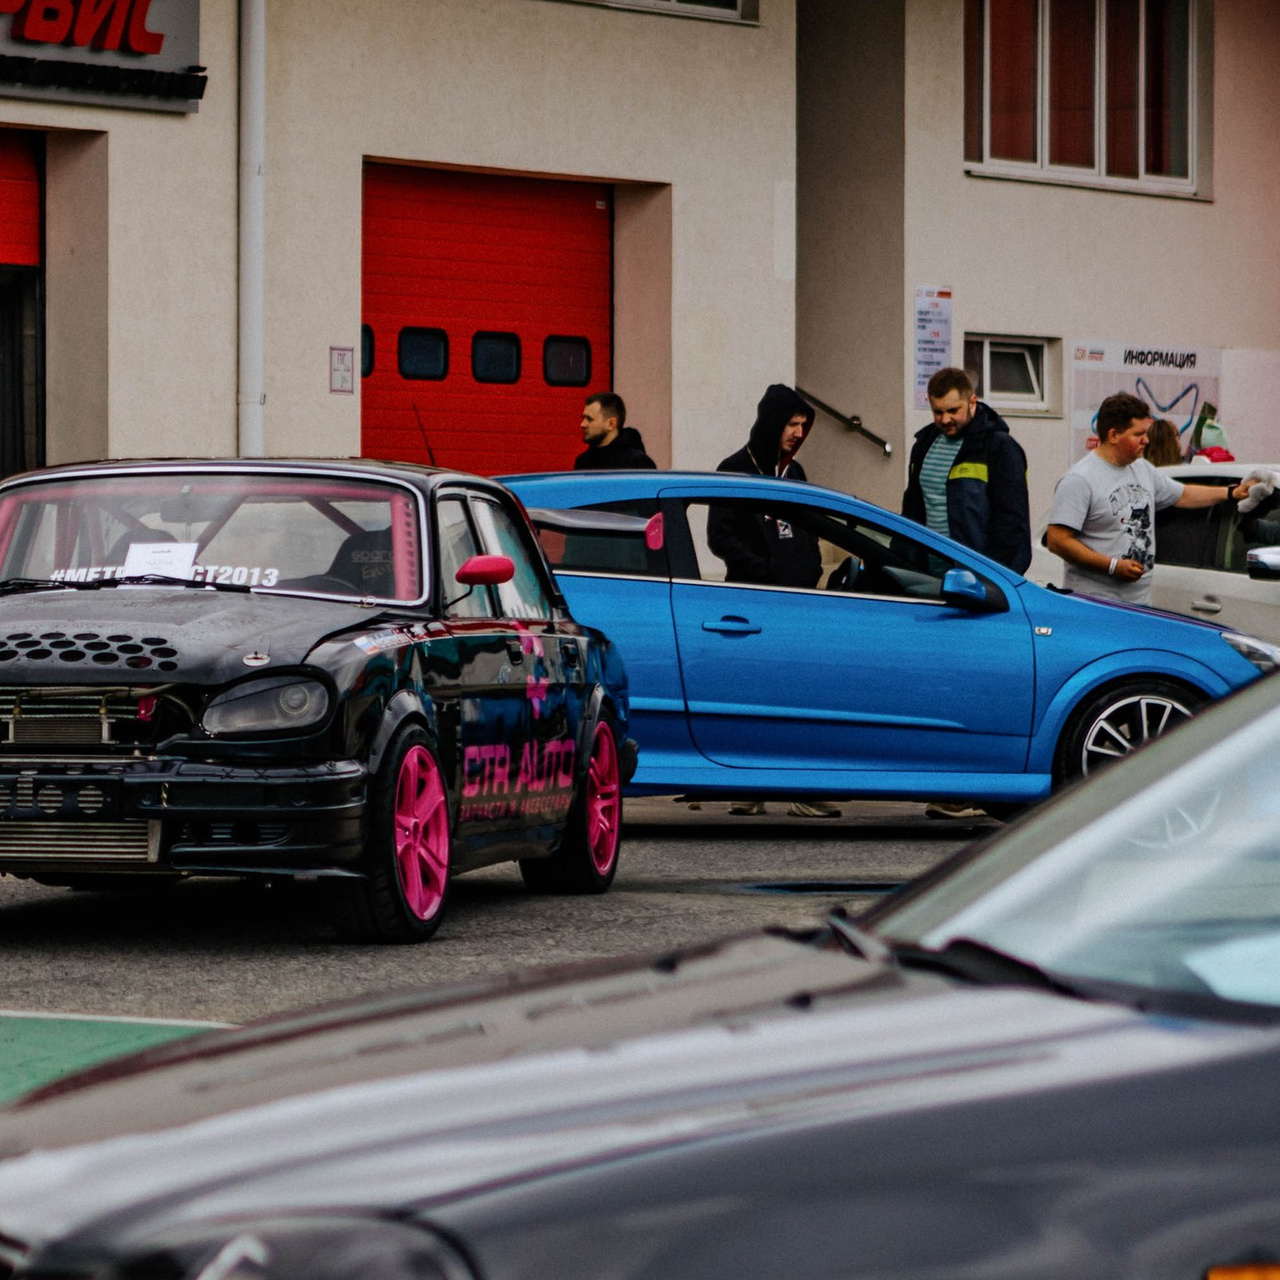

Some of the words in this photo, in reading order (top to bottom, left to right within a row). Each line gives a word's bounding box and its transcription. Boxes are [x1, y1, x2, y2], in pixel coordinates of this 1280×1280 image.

[1124, 349, 1196, 370] ИНФОРМАЦИЯ
[351, 550, 395, 562] spar
[514, 738, 576, 793] AUTO
